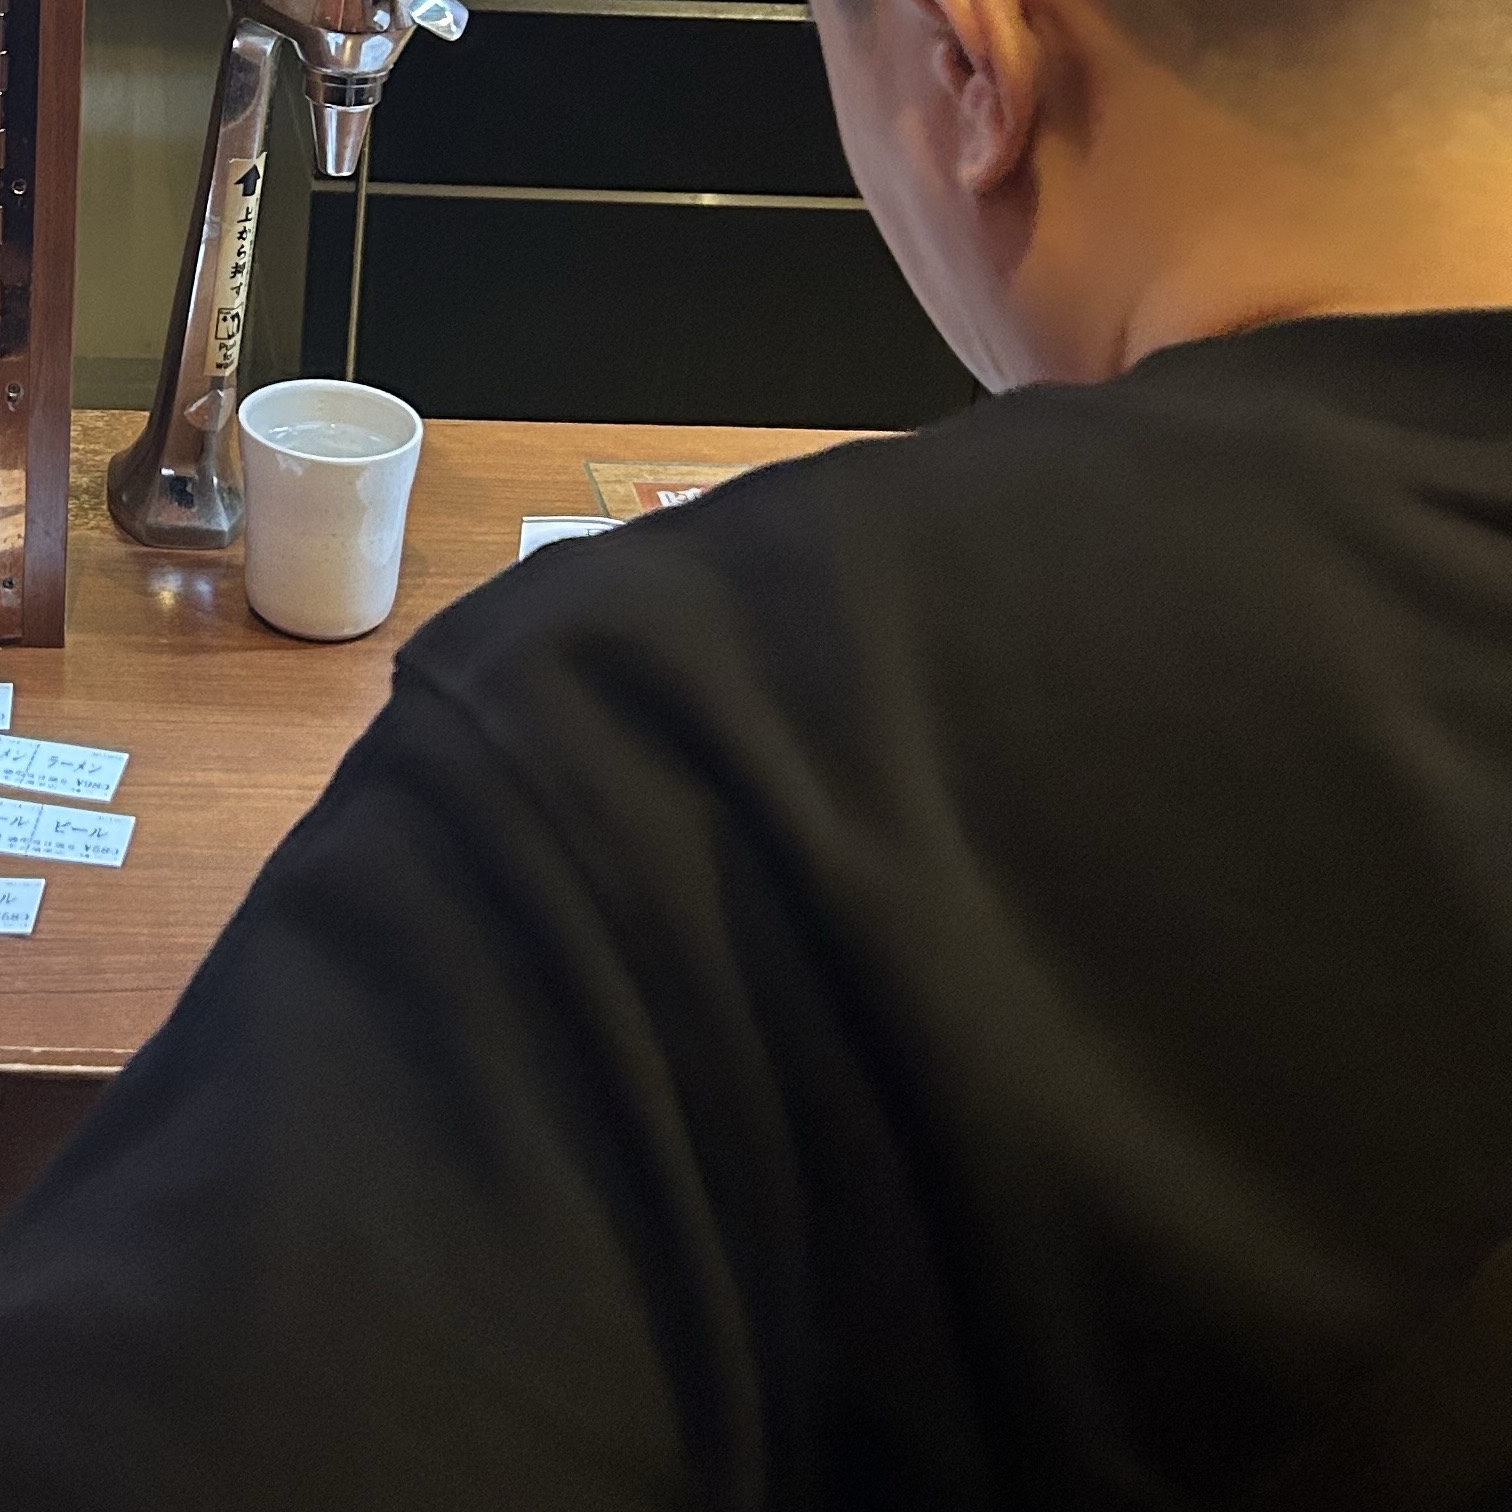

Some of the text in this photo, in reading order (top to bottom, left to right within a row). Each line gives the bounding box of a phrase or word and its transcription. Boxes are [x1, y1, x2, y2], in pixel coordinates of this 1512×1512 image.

[229, 205, 253, 301] 上から押す
[47, 755, 103, 774] ラーメン
[54, 820, 109, 838] ビール
